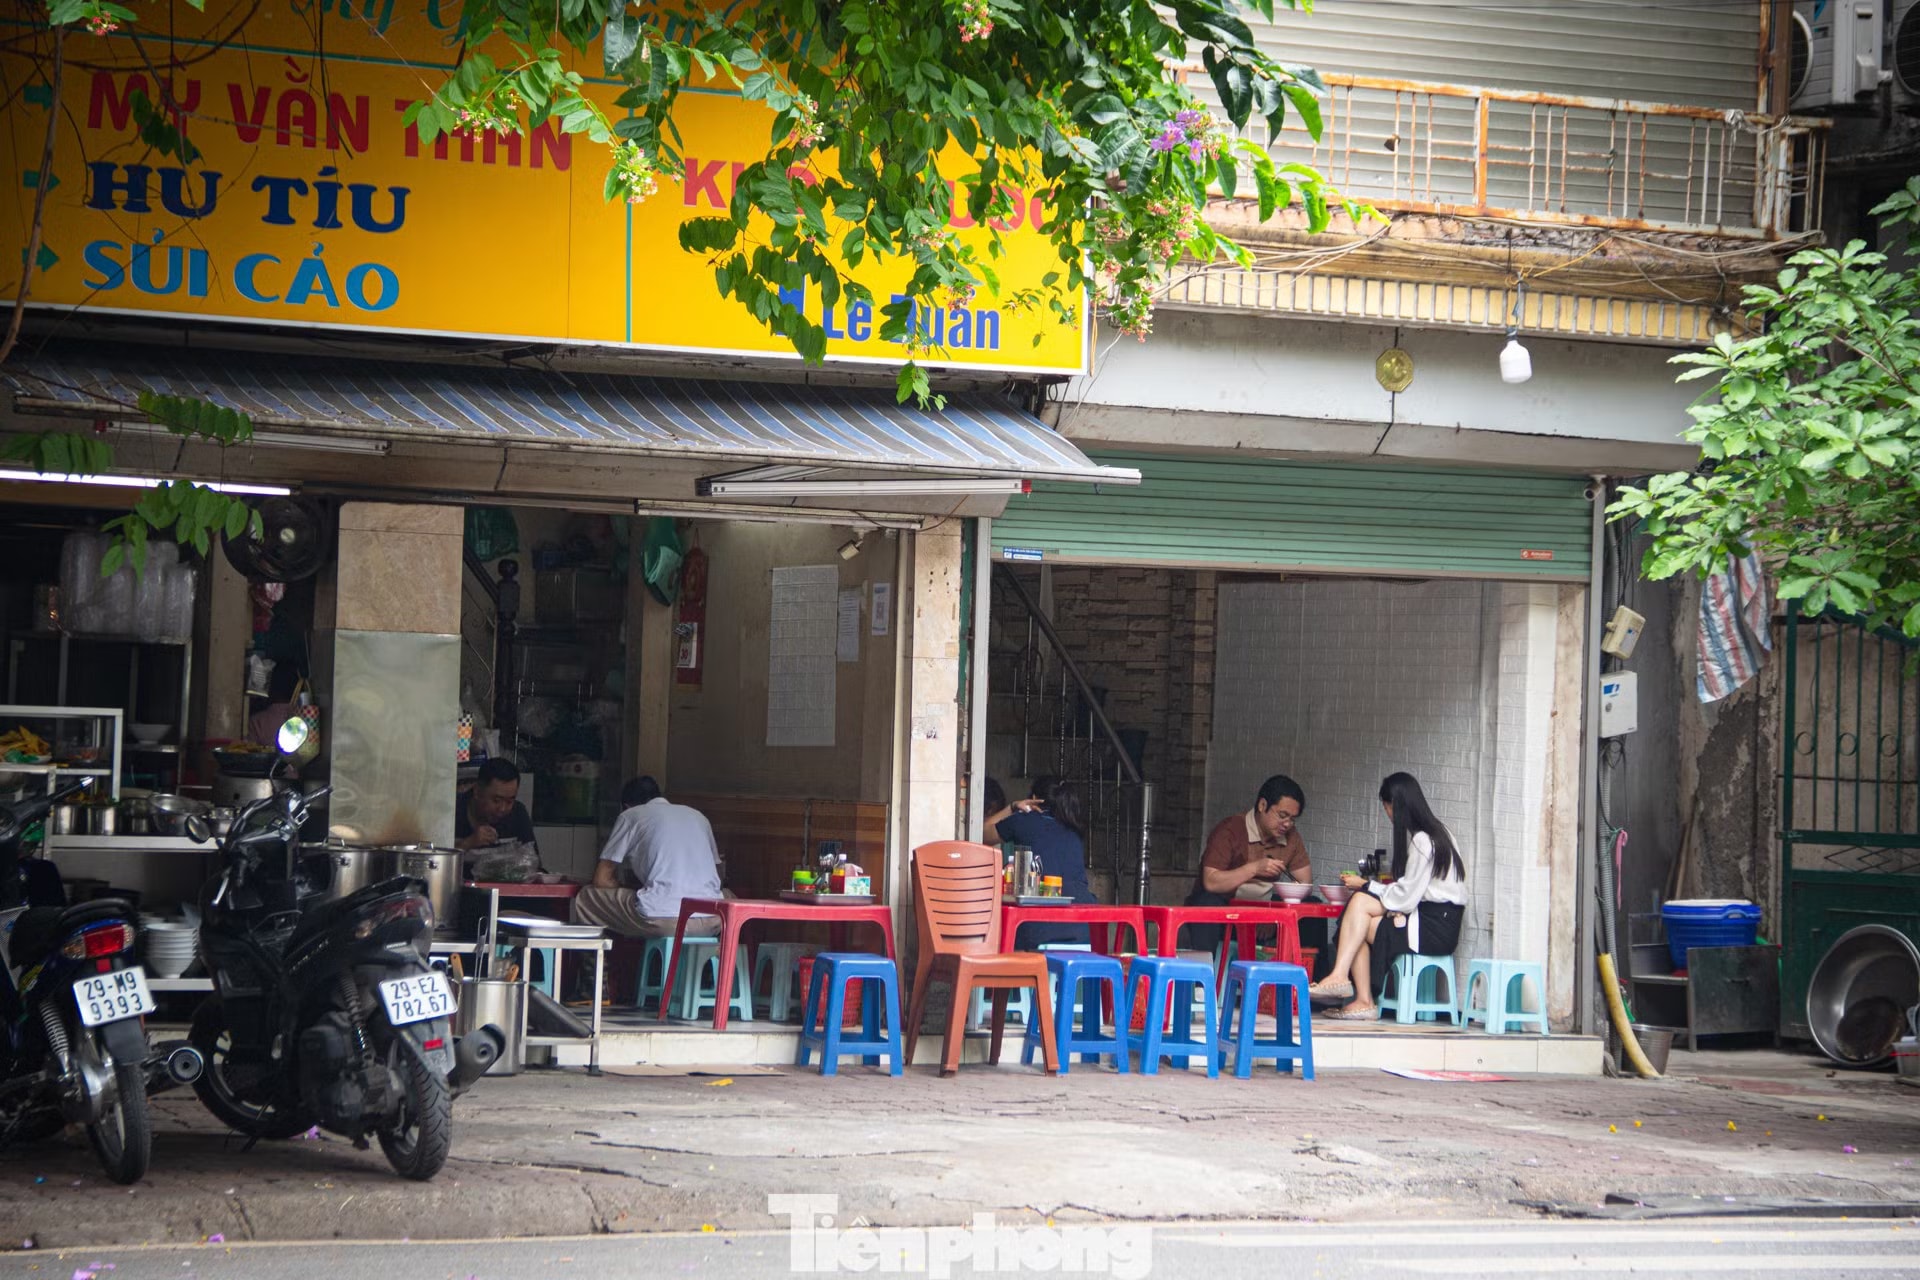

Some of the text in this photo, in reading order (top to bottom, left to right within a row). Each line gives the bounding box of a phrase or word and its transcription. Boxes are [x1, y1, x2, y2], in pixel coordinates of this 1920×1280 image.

[227, 56, 370, 153] VẰN
[251, 166, 411, 234] TÍU
[82, 228, 400, 311] SỦI CẢO
[83, 971, 137, 1001] 29-M9
[390, 976, 440, 1000] 29-E2
[90, 993, 143, 1022] 9393
[391, 993, 448, 1020] 782.67
